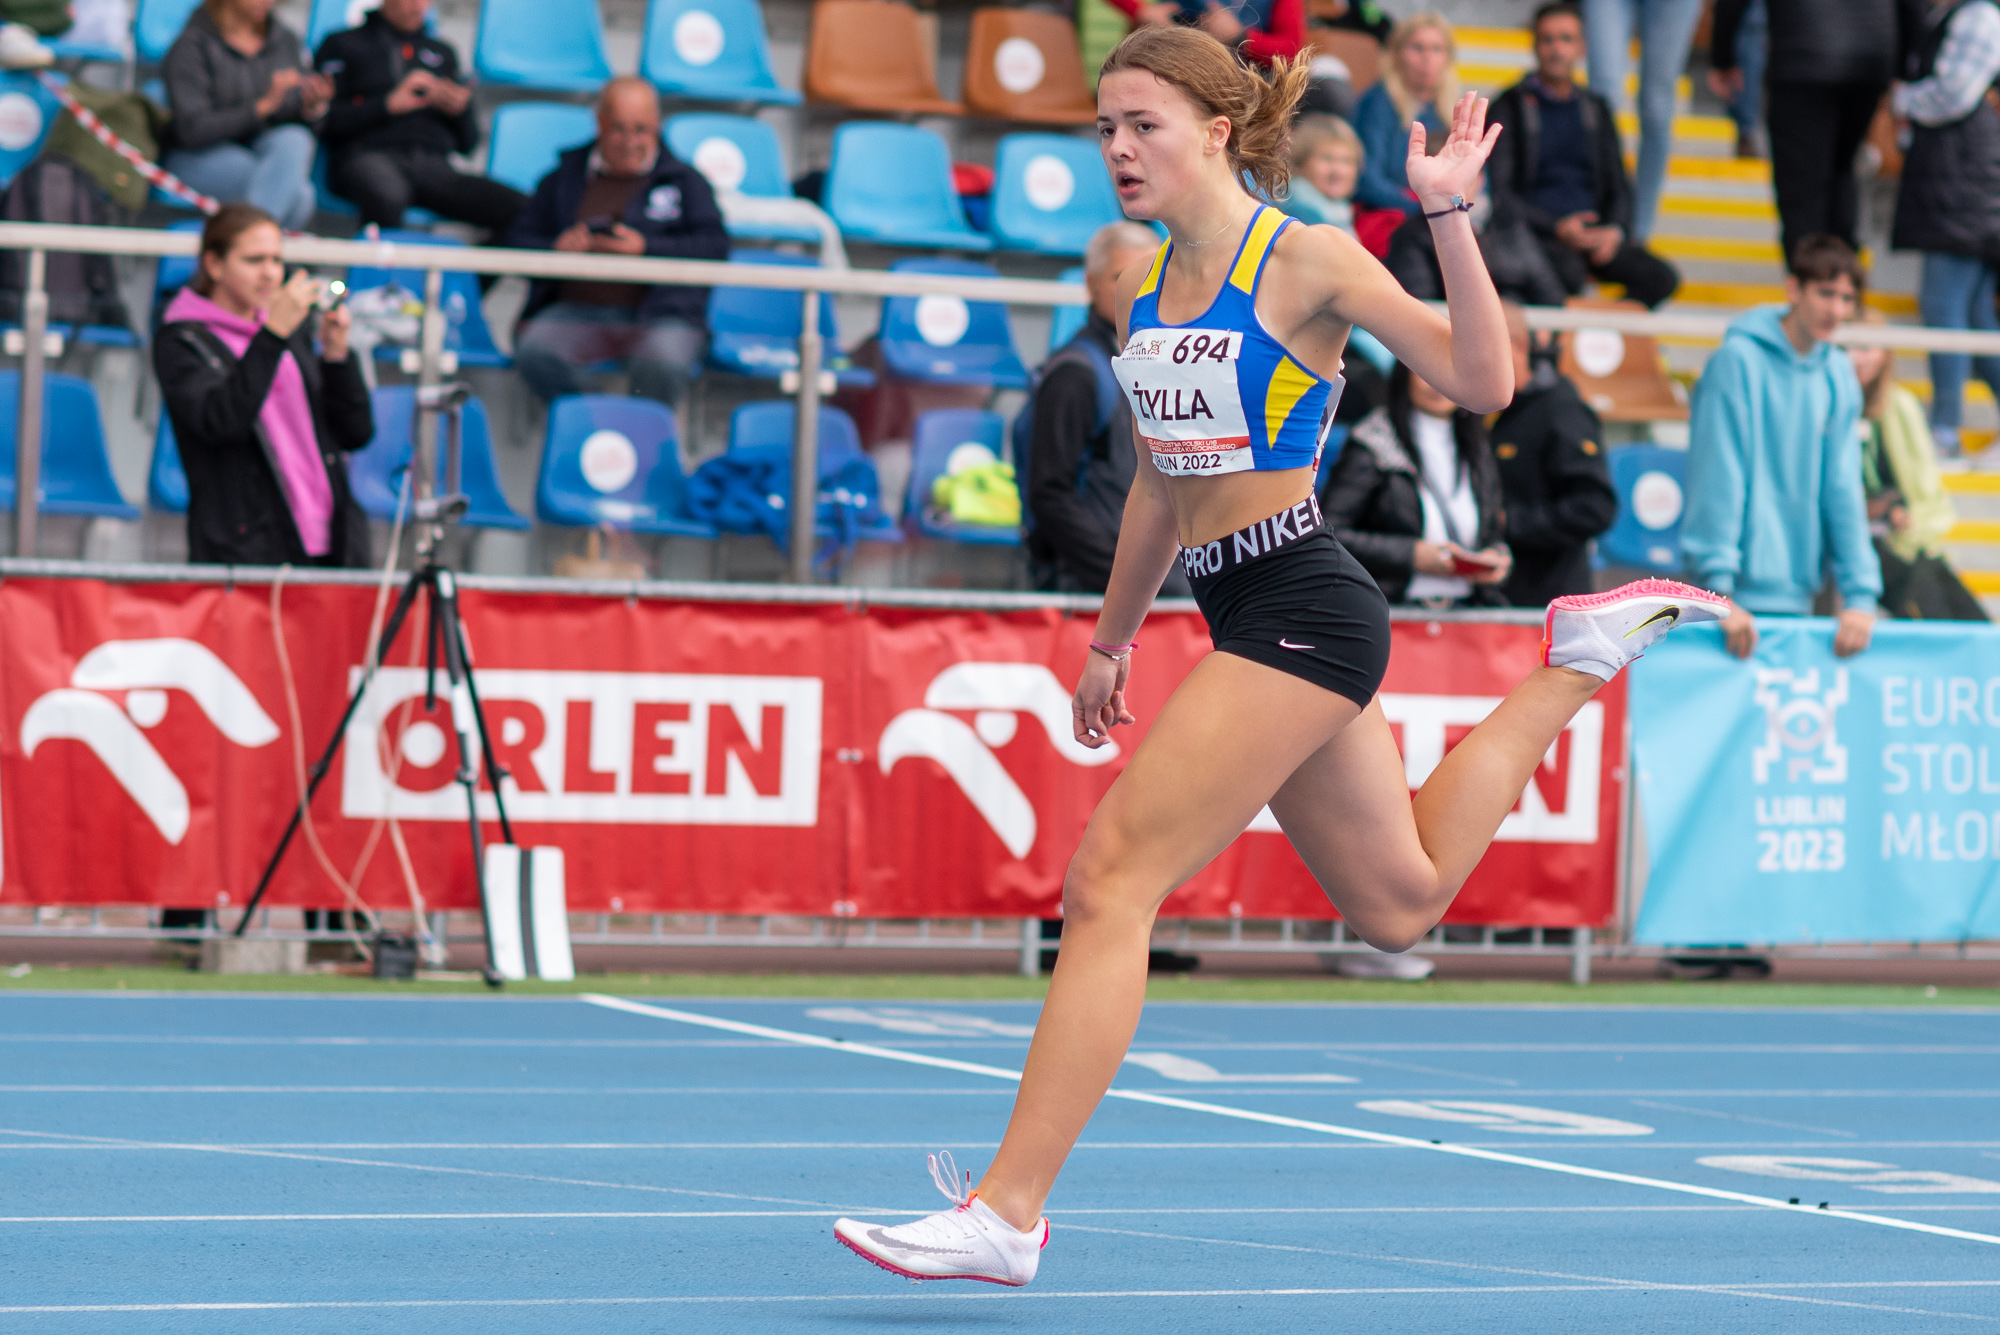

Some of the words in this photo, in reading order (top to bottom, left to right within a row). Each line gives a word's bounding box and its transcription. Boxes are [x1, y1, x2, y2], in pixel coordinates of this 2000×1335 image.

[1172, 334, 1231, 365] 694
[1132, 380, 1215, 421] ŻYLLA
[1181, 453, 1222, 470] 2022
[1182, 440, 1205, 448] POLSKI
[1185, 540, 1224, 578] PRO
[1233, 500, 1314, 564] NIKE
[378, 694, 785, 797] ORLEN
[1883, 743, 2000, 795] STOL
[1755, 795, 1846, 826] LUBLIN
[1757, 829, 1847, 873] 2023
